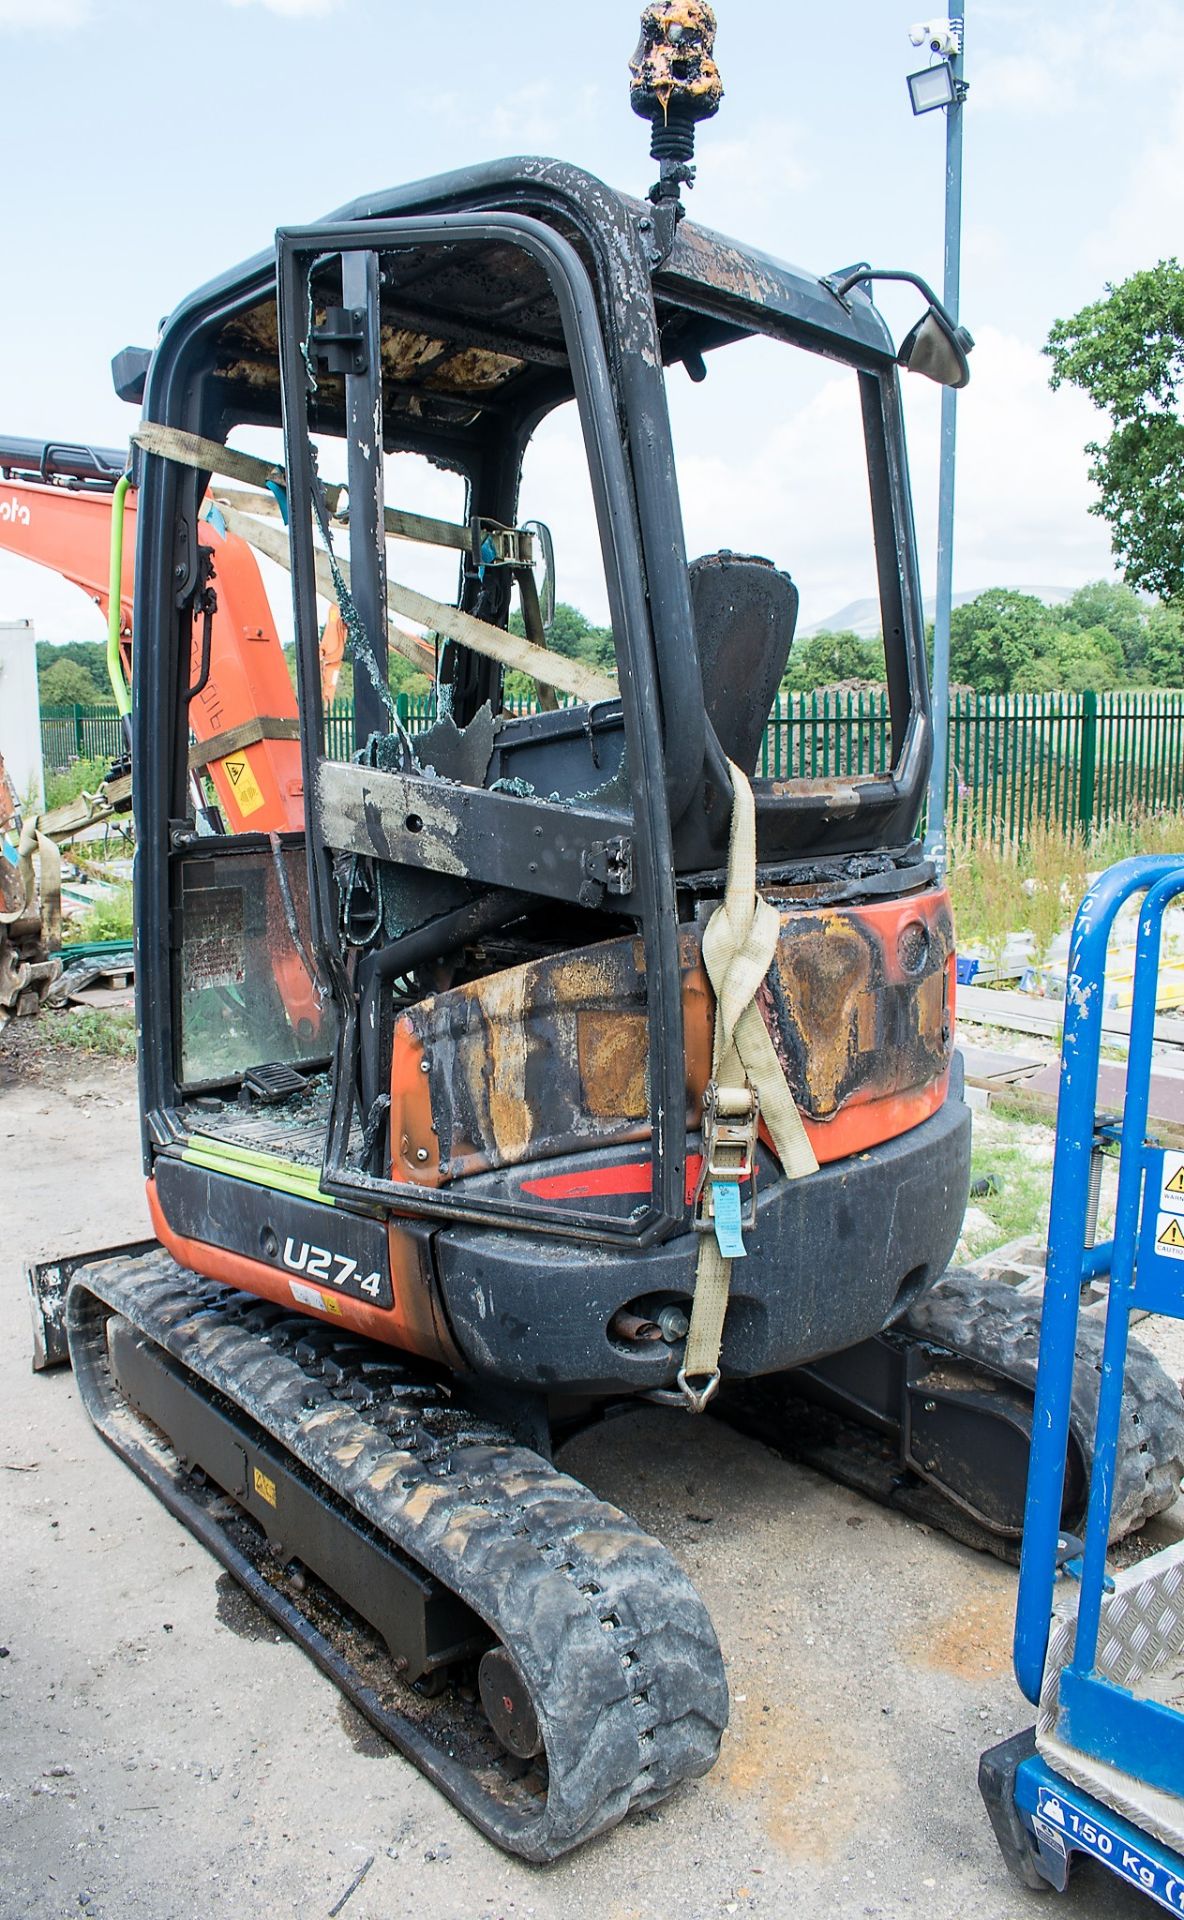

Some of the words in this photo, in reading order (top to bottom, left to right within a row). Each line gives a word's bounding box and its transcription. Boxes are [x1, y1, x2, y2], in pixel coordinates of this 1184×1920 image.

[283, 1236, 382, 1298] U27-4
[1069, 1813, 1112, 1855] 150
[1122, 1850, 1155, 1888] Kg
